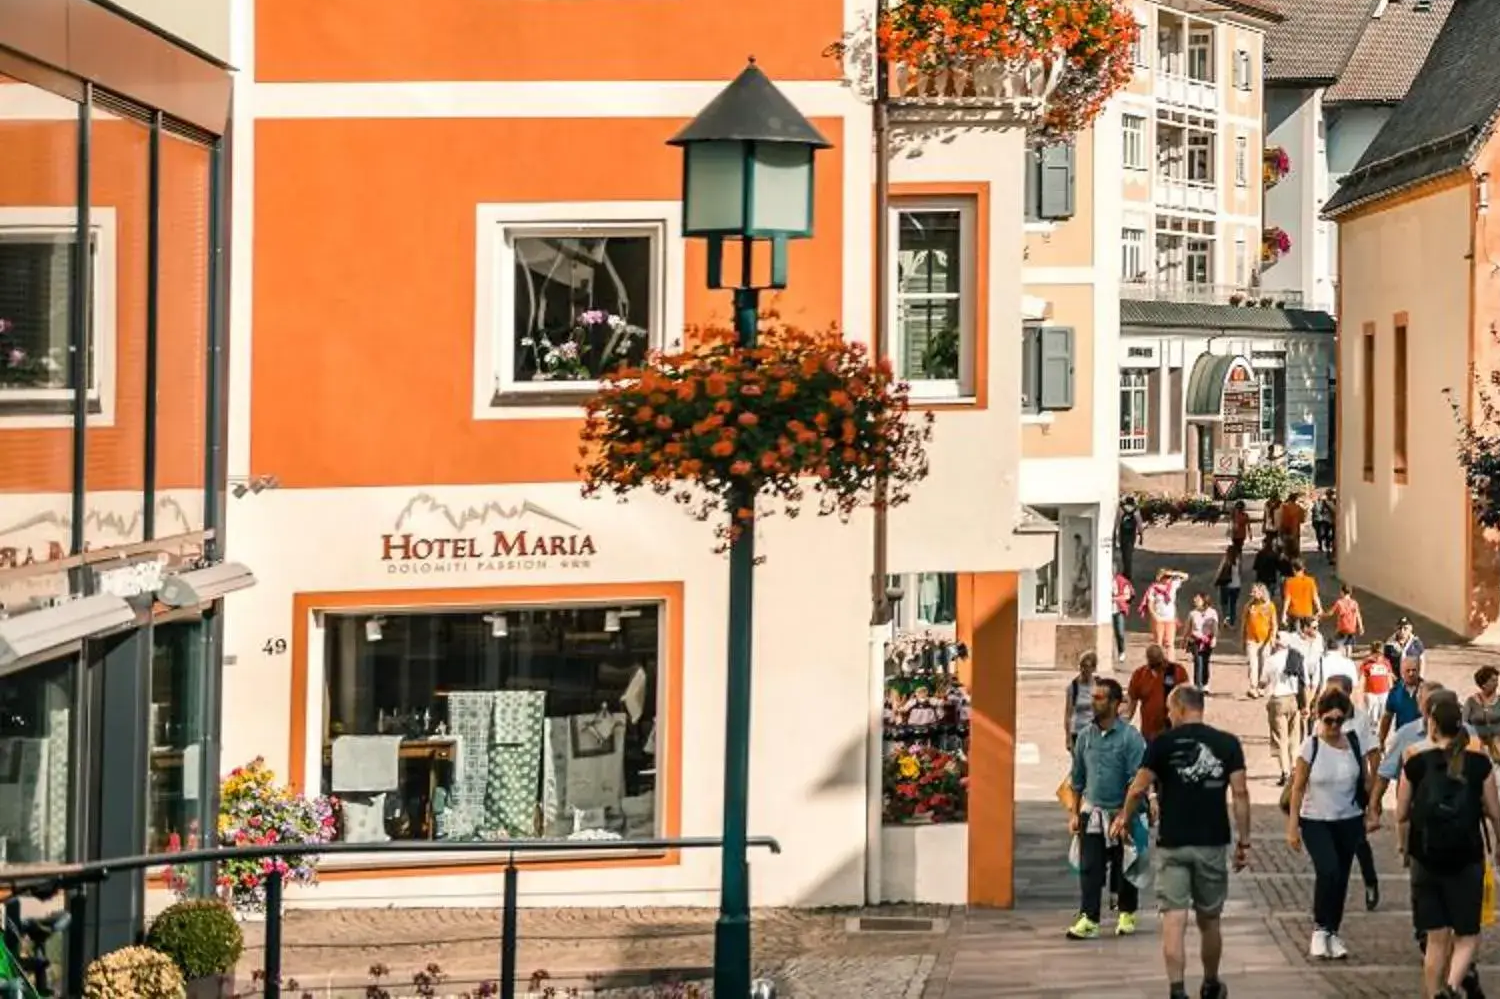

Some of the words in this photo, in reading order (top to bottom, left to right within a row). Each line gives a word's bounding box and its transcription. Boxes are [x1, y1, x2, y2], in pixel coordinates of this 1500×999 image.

[387, 562, 467, 575] DOLOMITI
[477, 558, 547, 571] PASSION
[262, 637, 287, 655] 49
